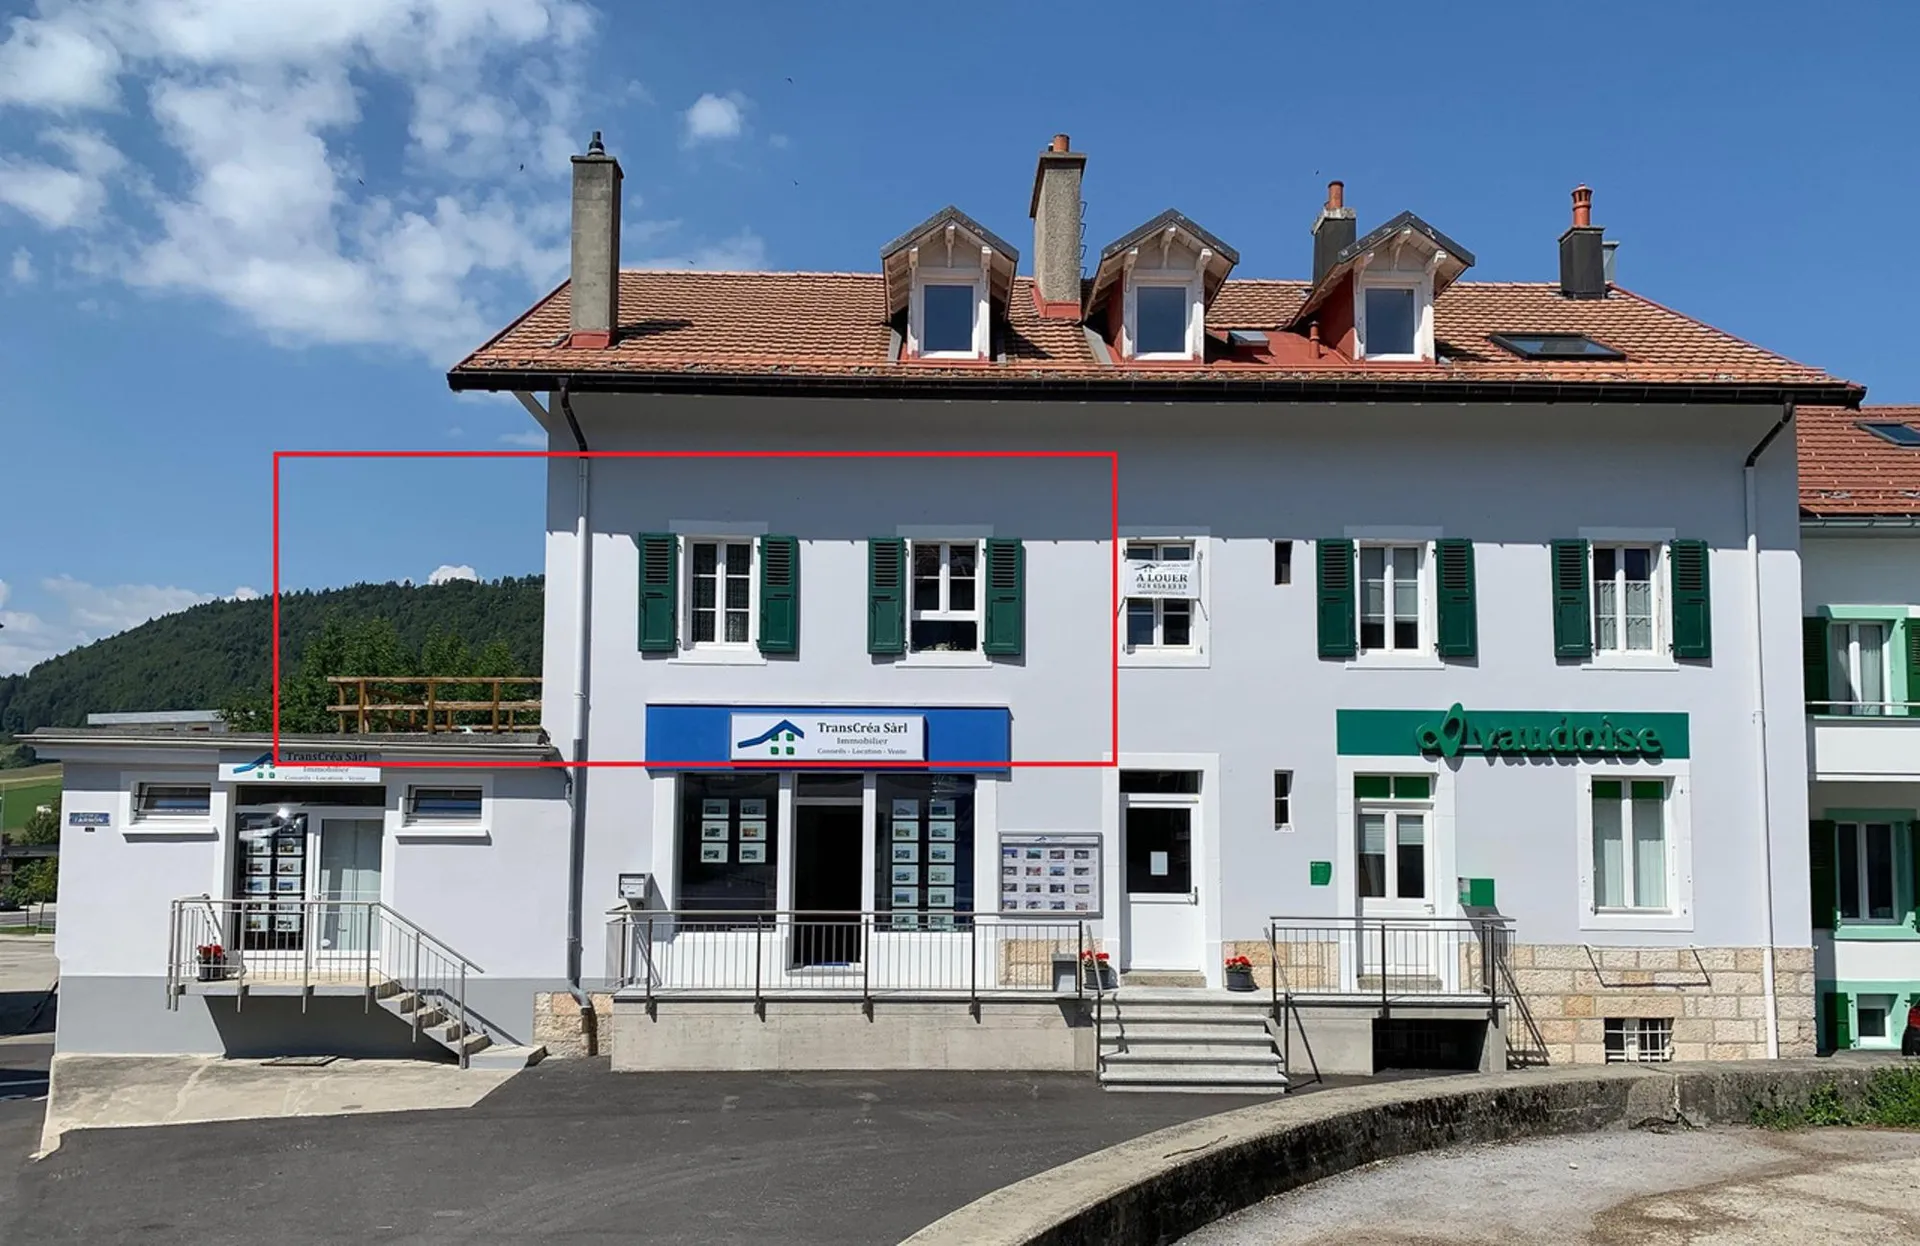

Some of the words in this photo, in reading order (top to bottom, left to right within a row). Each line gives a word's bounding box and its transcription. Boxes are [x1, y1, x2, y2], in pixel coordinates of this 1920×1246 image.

[1148, 574, 1188, 583] LOUER
[817, 722, 881, 733] TransCréa
[1476, 714, 1662, 752] vaudoise
[836, 737, 888, 745] Immobilier
[852, 747, 882, 755] Location
[285, 751, 343, 761] TransCréa
